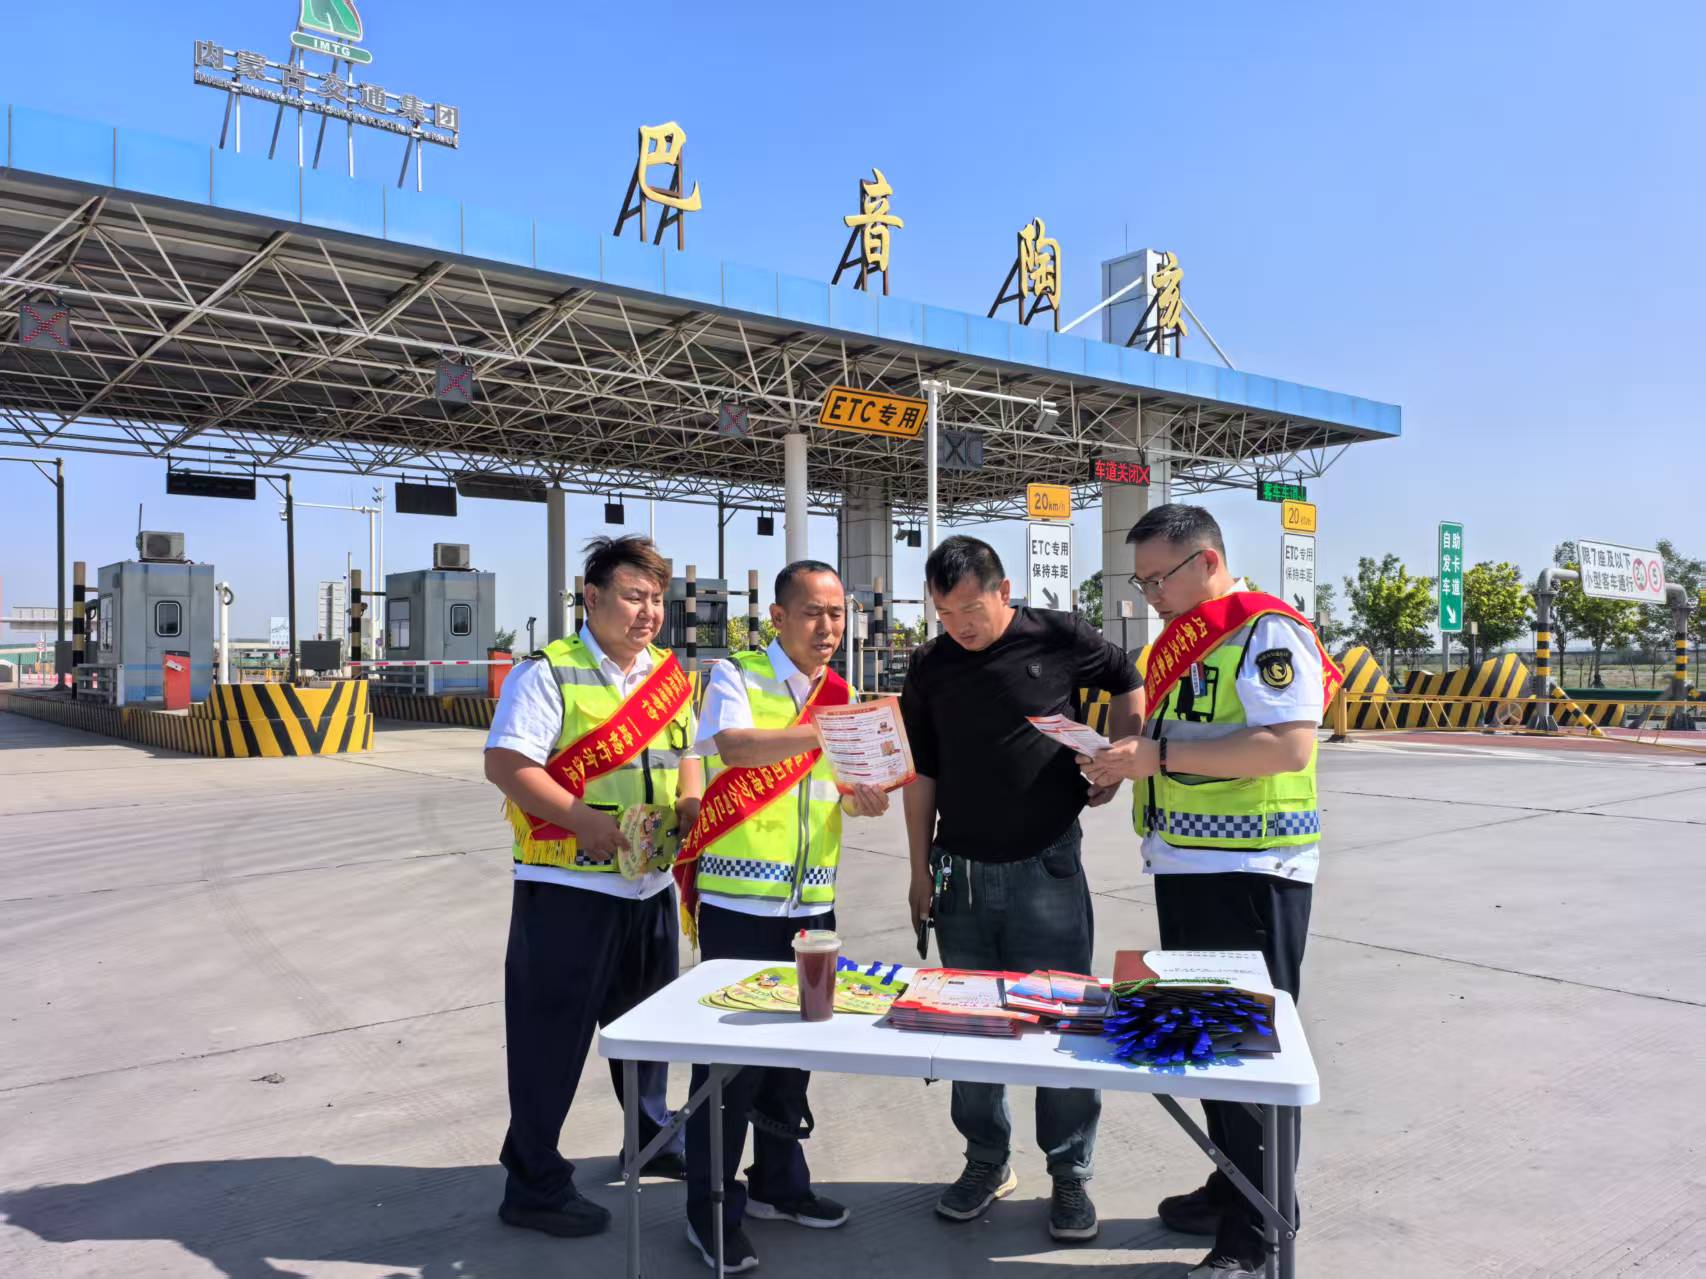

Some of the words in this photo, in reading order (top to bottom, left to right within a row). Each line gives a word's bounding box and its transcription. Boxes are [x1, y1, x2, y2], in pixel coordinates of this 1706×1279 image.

[314, 39, 351, 57] IMTG
[194, 40, 460, 132] 内蒙古交通集团
[829, 396, 920, 430] ETC专用
[1031, 539, 1069, 557] ETC专用
[1443, 530, 1461, 550] 自助
[1032, 563, 1069, 579] 保持车距
[1442, 554, 1461, 573] 发卡
[1442, 577, 1461, 596] 车道
